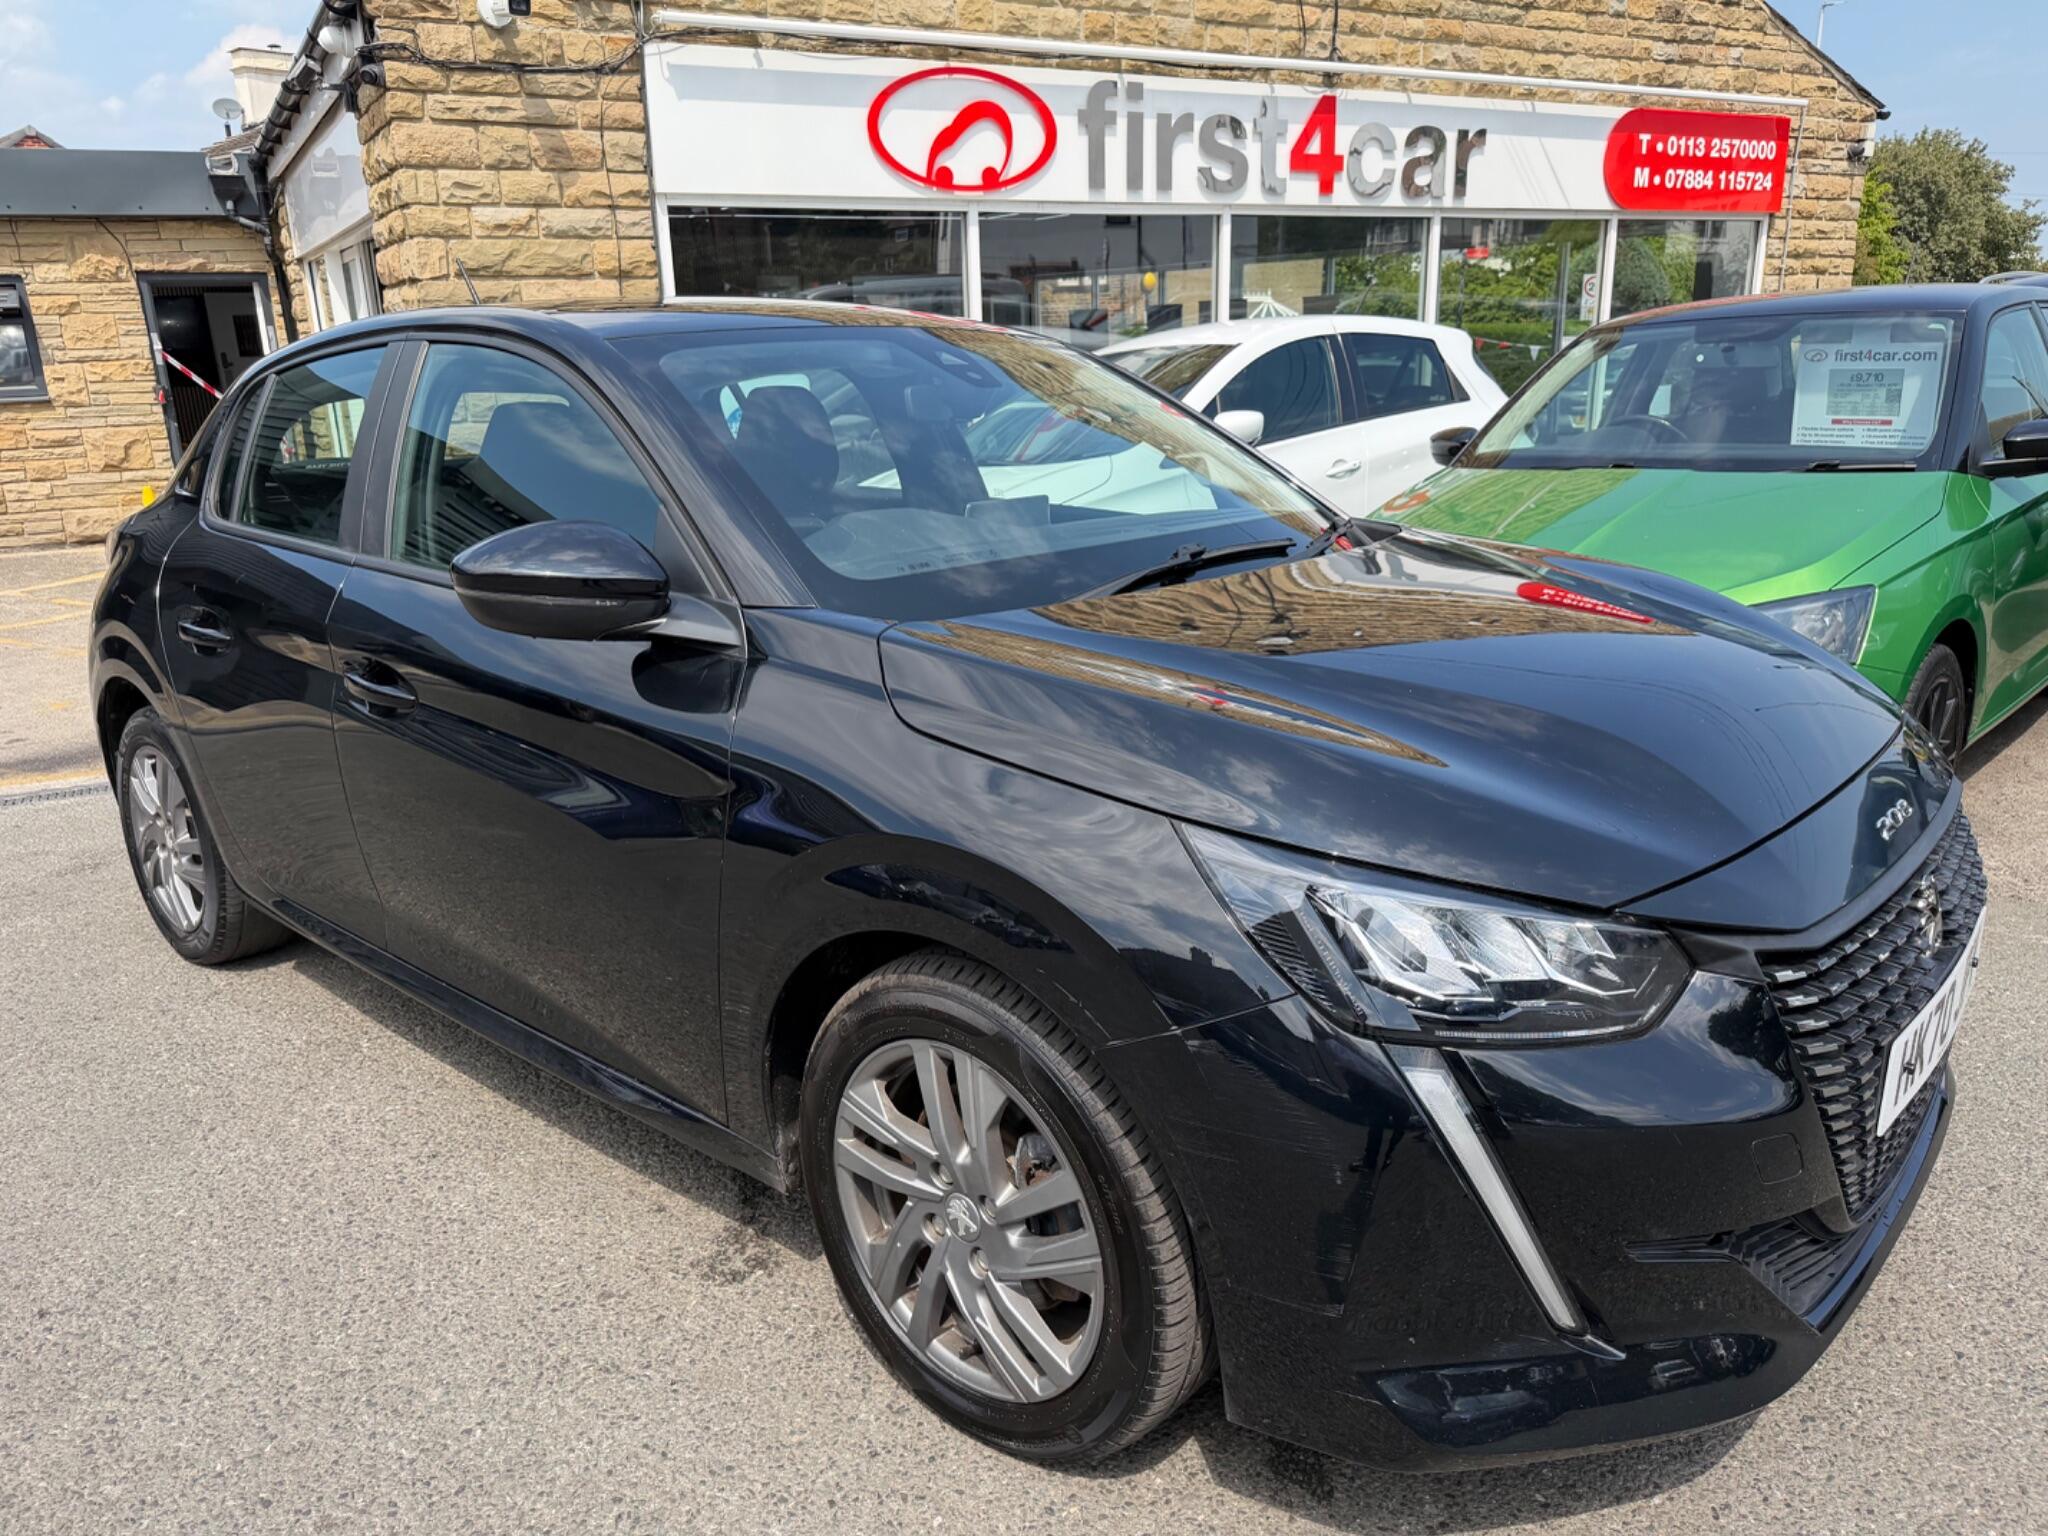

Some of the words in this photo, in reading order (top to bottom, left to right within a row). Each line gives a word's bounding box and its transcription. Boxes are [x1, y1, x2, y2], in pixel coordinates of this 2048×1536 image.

[1078, 79, 1487, 197] first4car
[1639, 134, 1651, 155] T
[1667, 136, 1705, 157] 0113
[1710, 138, 1776, 160] 2570000
[1634, 167, 1650, 188] M
[1665, 169, 1713, 190] 07884
[1718, 172, 1772, 191] 115724
[1834, 349, 1937, 363] first4car.com
[1876, 798, 1913, 841] 208
